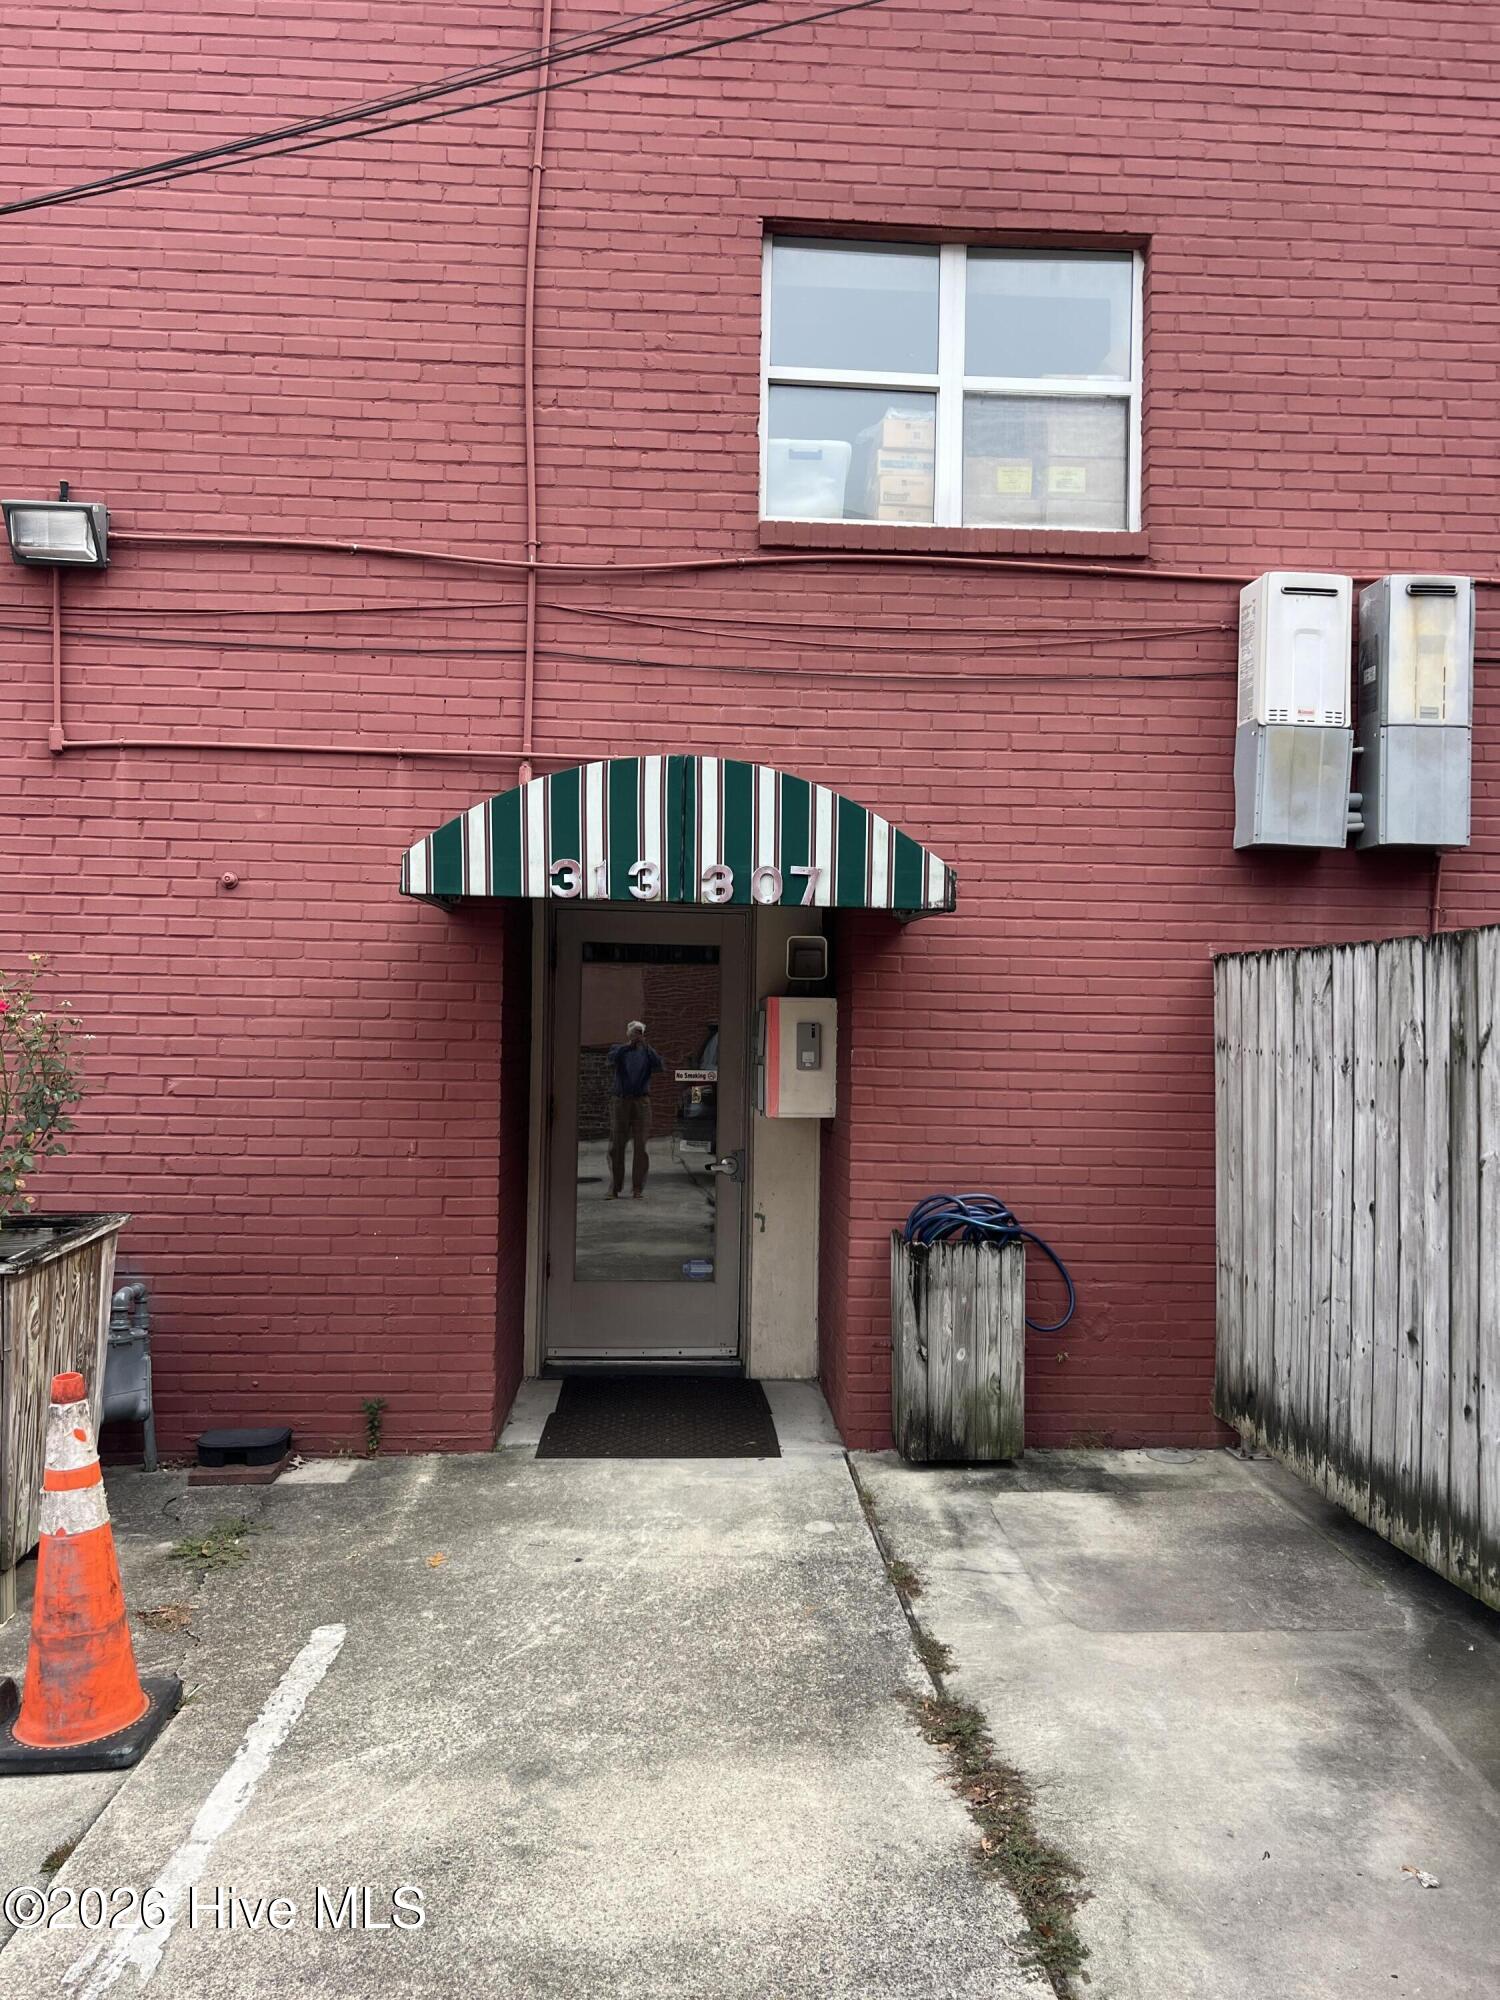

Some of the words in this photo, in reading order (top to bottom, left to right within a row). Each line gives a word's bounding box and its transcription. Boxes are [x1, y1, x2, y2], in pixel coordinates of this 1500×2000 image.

[550, 858, 661, 900] 313
[702, 863, 823, 906] 307
[685, 1072, 707, 1080] Smoking
